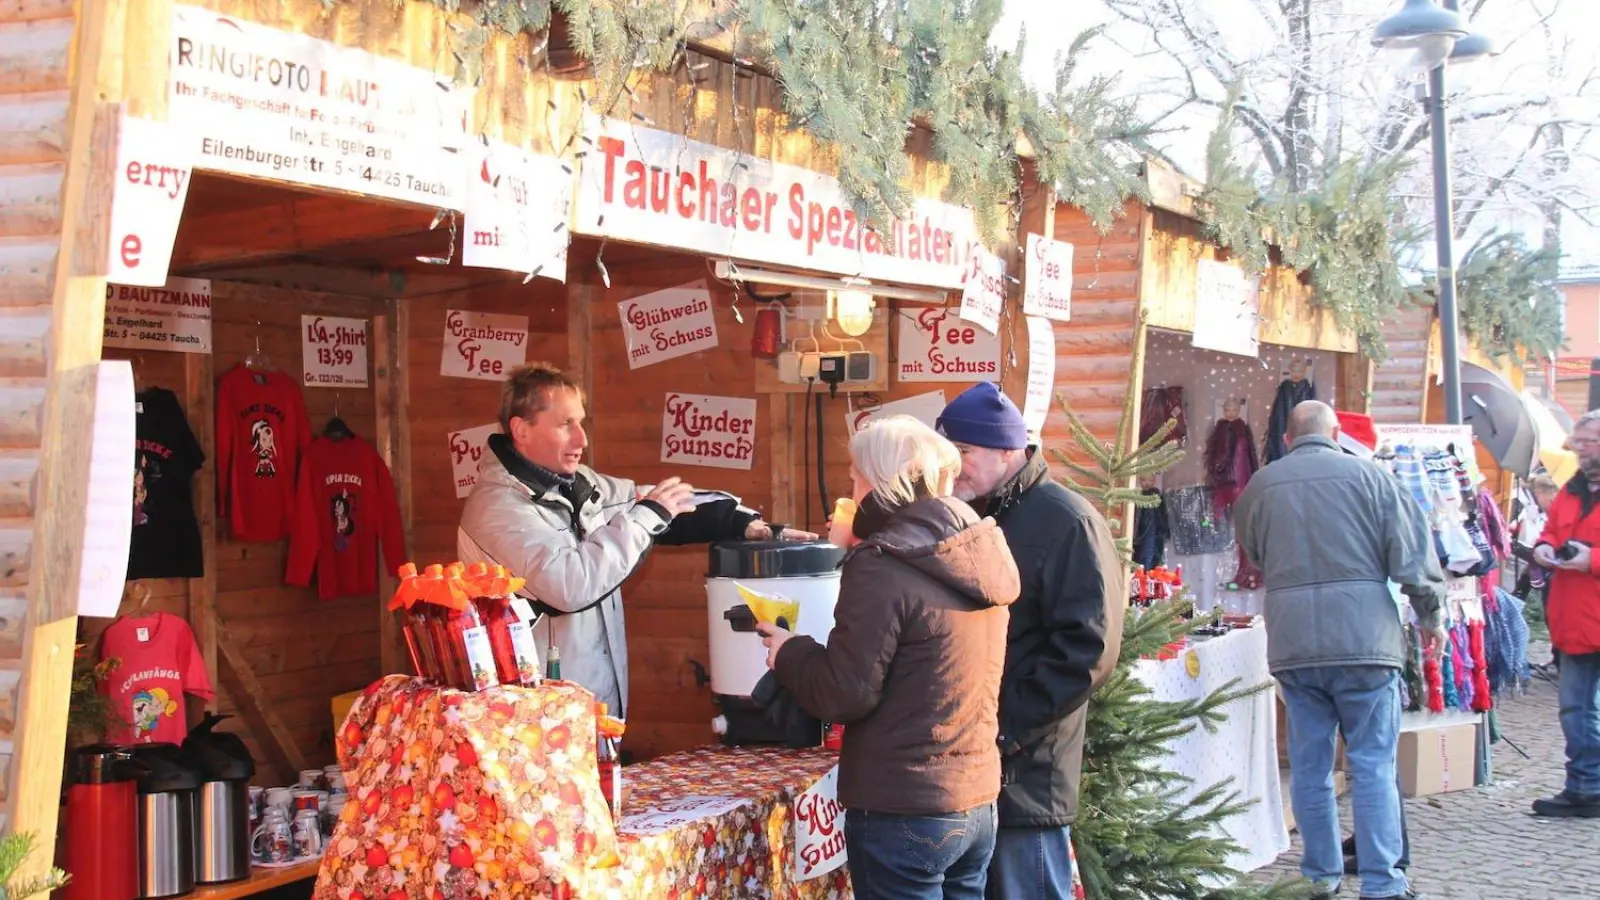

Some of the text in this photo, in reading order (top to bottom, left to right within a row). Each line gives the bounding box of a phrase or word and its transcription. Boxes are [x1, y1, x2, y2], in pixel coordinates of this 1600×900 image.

[202, 137, 299, 170] Eilenburger
[597, 136, 778, 234] Tauchaer
[788, 181, 958, 266] Speziaitäten
[120, 286, 210, 308] BAUTZMANN
[447, 311, 525, 347] Cranberry
[627, 298, 708, 331] Glühwein
[918, 307, 975, 345] Tee
[170, 334, 200, 344] Taucha
[631, 327, 713, 359] mit Schuss
[457, 338, 503, 374] Tee
[901, 346, 996, 374] mit Schuss
[666, 394, 753, 437] Kinder
[457, 474, 476, 488] mit
